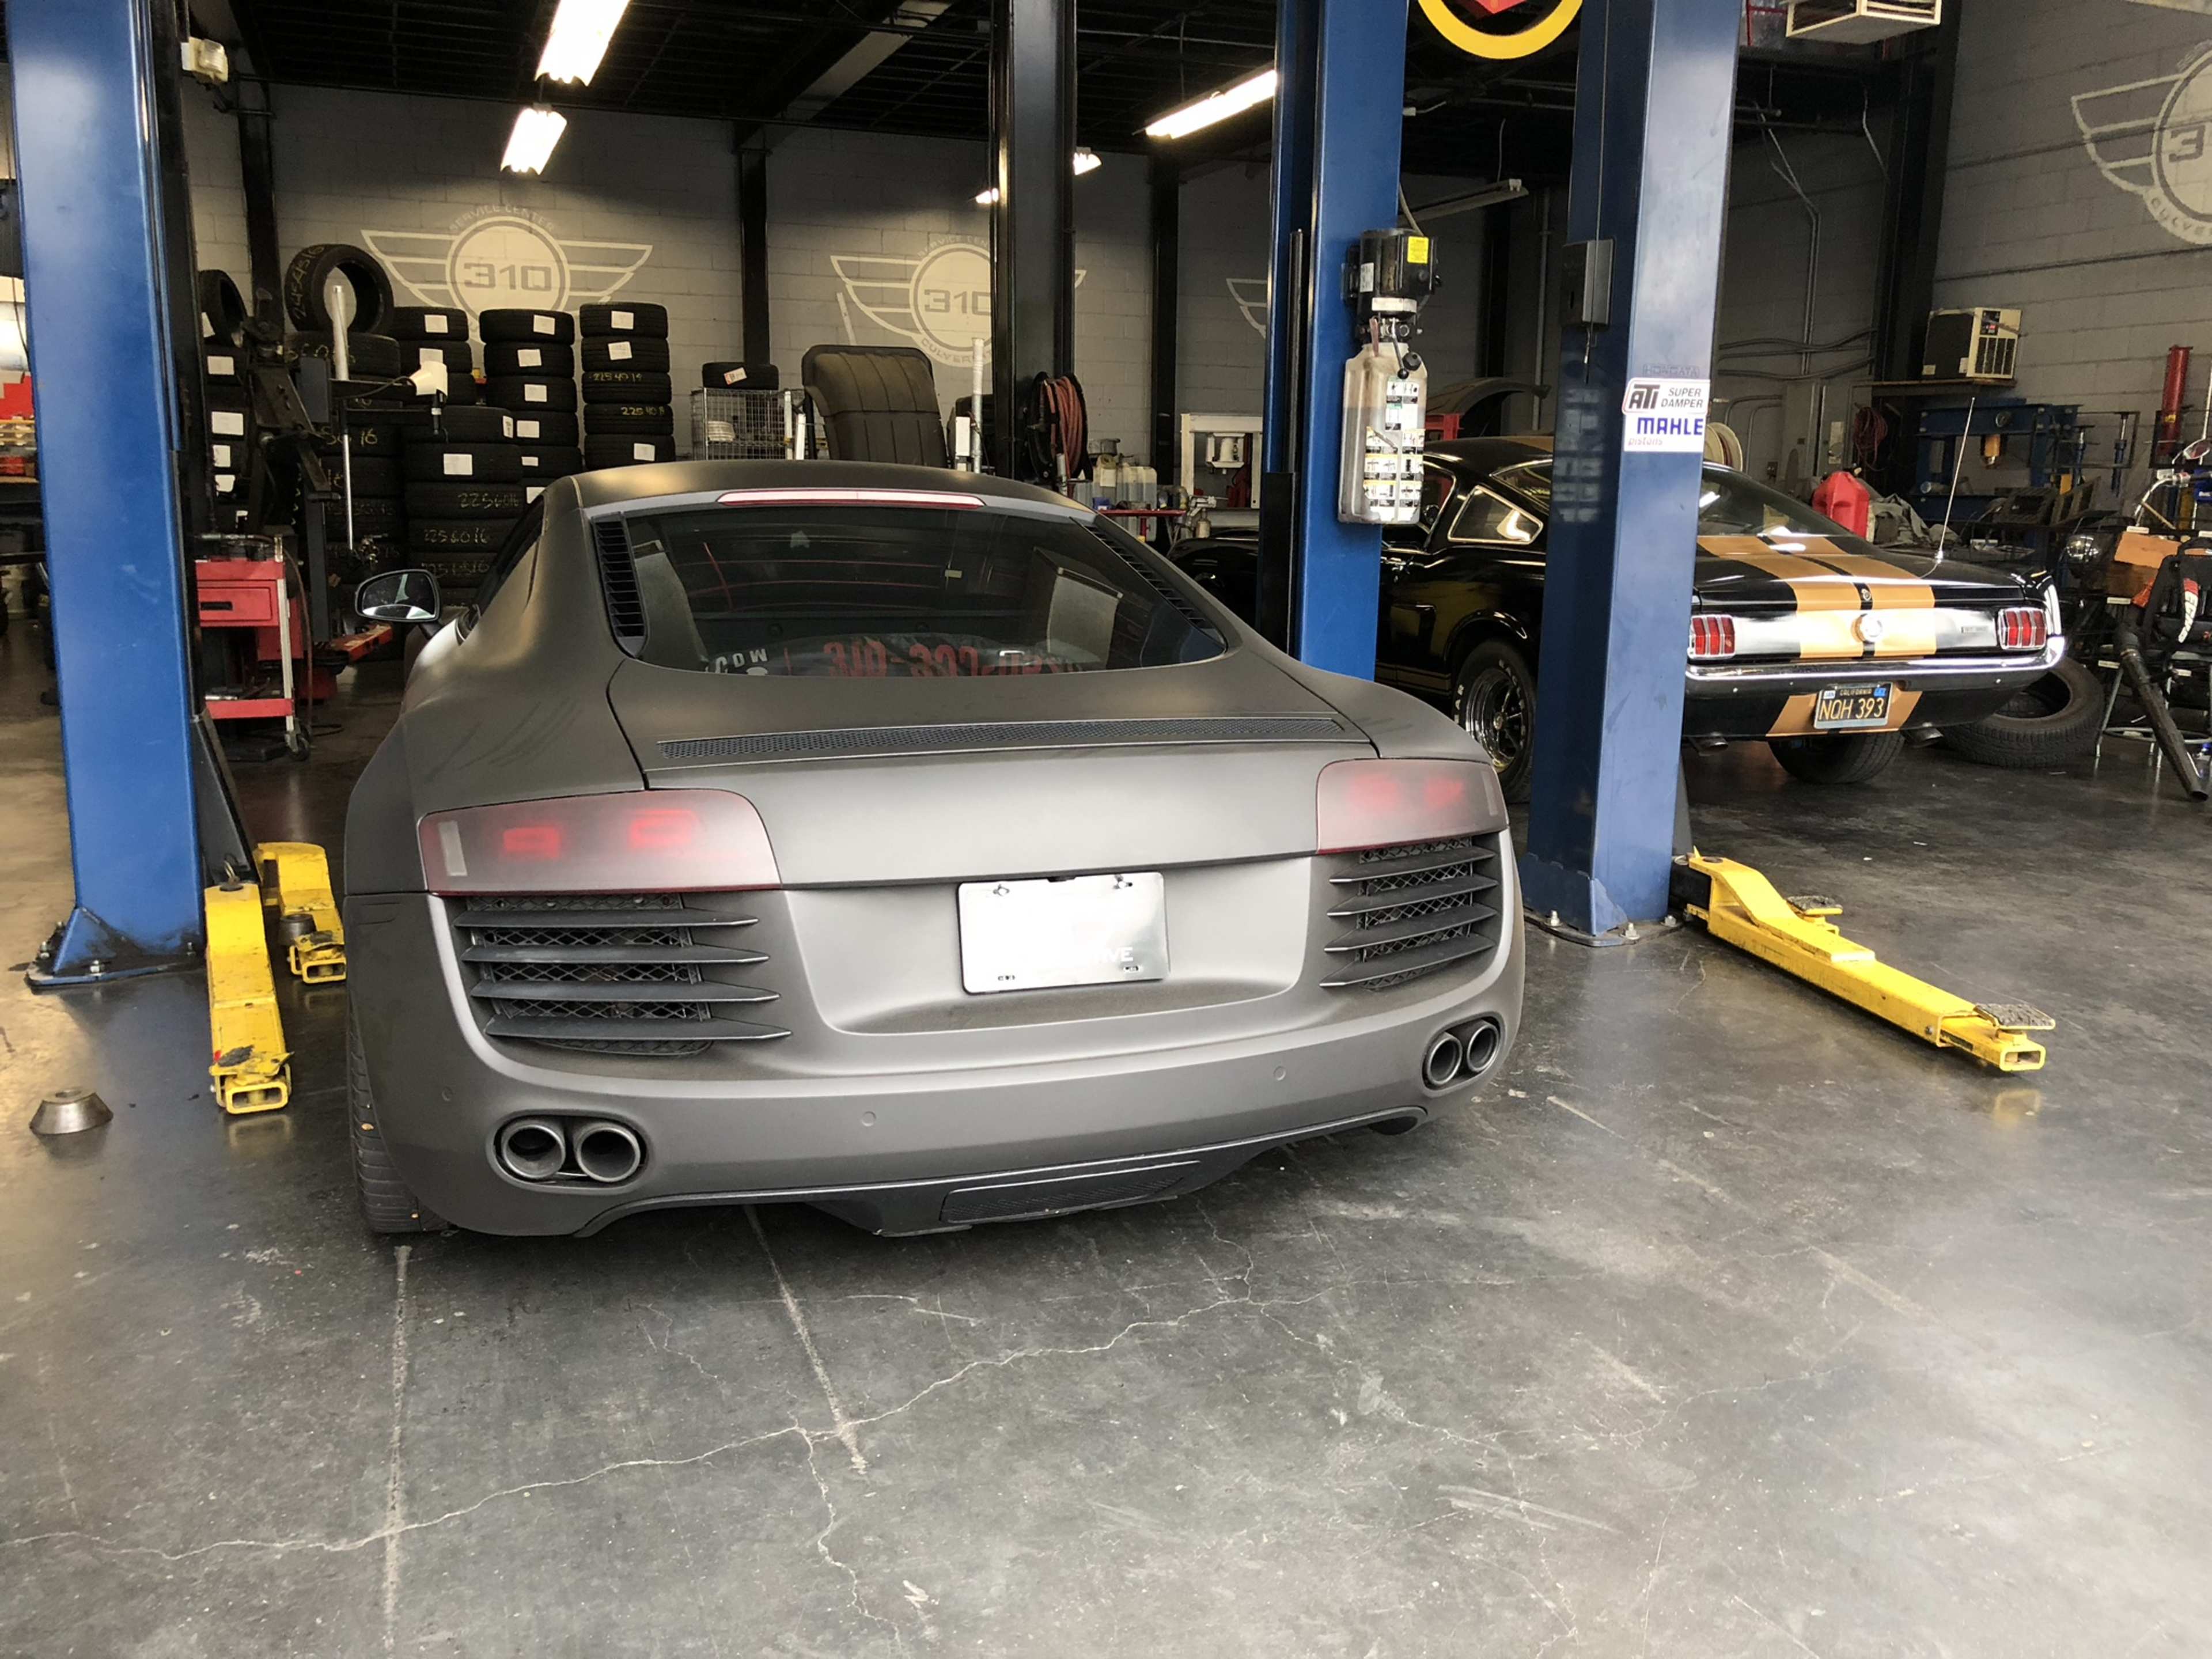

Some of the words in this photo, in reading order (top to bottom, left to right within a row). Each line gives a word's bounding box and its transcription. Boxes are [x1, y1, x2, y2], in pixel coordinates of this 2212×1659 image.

[449, 204, 501, 231] SERVICE
[505, 204, 555, 231] CENTER
[464, 262, 552, 291] 310
[1628, 384, 1660, 409] ATI
[1668, 387, 1701, 397] SUPER
[1661, 399, 1703, 408] DAMPER
[1637, 417, 1704, 435] MAHLE
[1628, 437, 1663, 446] pistons
[1855, 697, 1884, 719] 393
